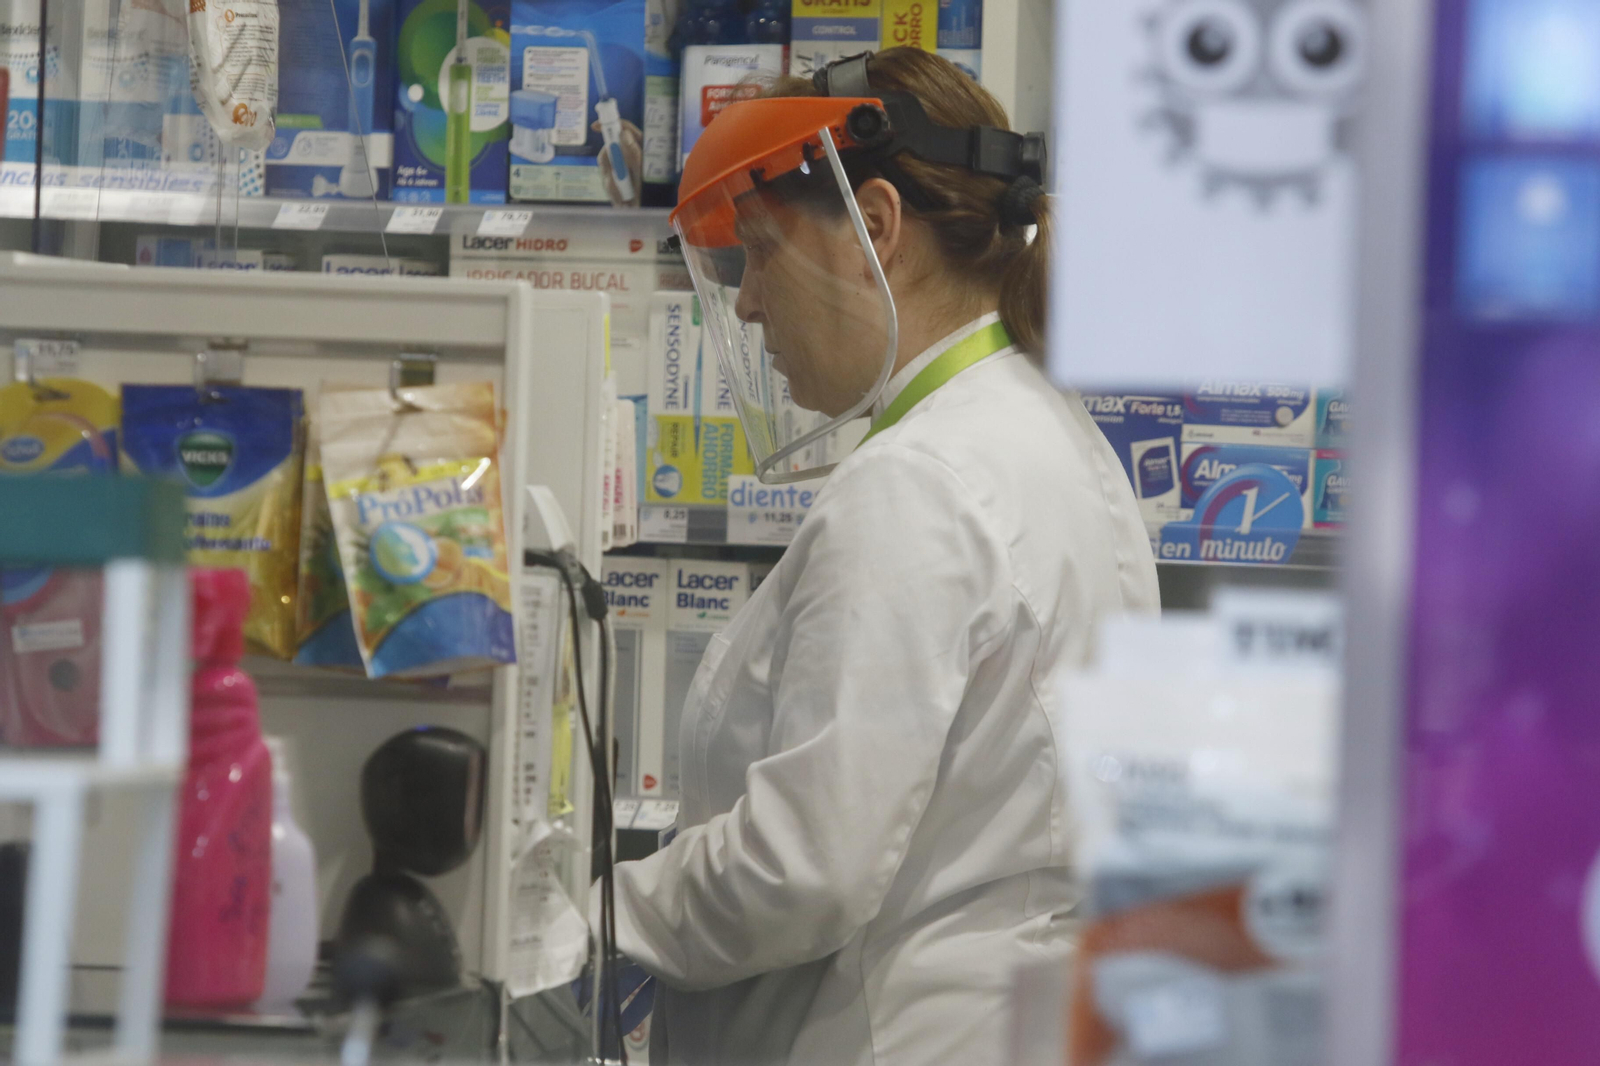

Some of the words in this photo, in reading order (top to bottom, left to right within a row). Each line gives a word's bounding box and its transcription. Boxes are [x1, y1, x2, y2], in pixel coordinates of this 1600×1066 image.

[893, 12, 908, 49] CK
[463, 235, 513, 250] Lacer
[516, 239, 569, 252] HIDRO
[570, 271, 631, 292] BUCAL
[664, 302, 682, 411] SENSODYNE
[1129, 401, 1165, 416] Forte
[702, 423, 719, 499] AHORRO
[1200, 536, 1288, 562] minuto
[676, 567, 739, 591] Lacer
[676, 592, 730, 611] Blanc
